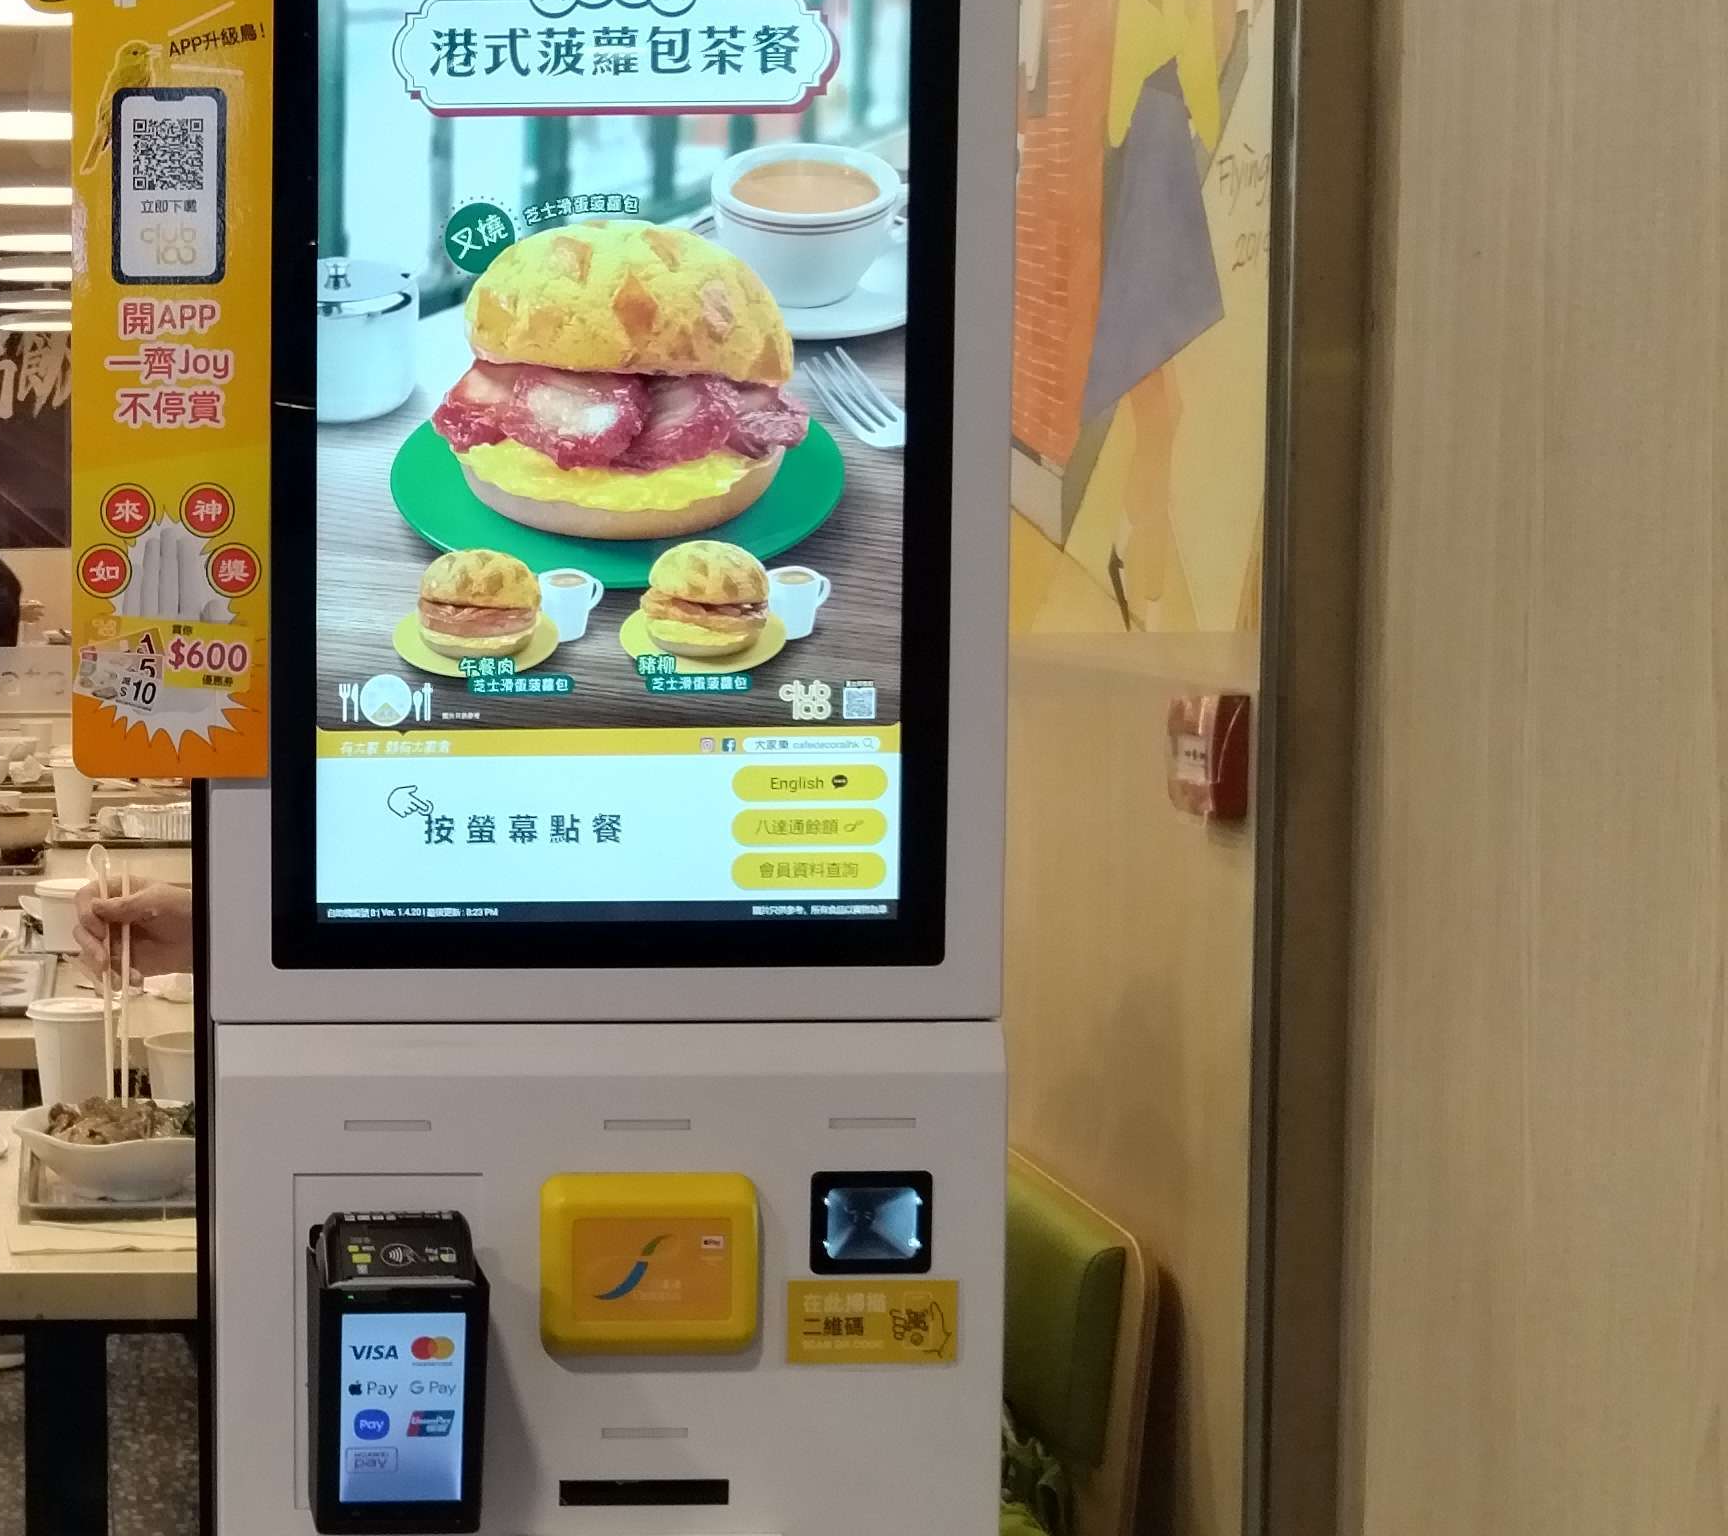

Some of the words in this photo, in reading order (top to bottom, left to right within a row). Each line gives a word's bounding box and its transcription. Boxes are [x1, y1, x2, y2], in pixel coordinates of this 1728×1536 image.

[428, 24, 802, 78] 港式菠蘿包茶餐
[451, 213, 509, 260] 叉燒
[122, 302, 218, 336] 開APP
[108, 346, 231, 380] 一齊Joy
[118, 390, 222, 425] 不停賞
[168, 637, 248, 673] $600
[459, 658, 514, 676] 午餐肉
[638, 657, 676, 675] 豬柳
[770, 777, 824, 793] English
[423, 814, 623, 845] 按螢幕點餐
[759, 862, 859, 879] 會員資料查詢
[802, 1316, 865, 1337] 二維碼
[349, 1344, 399, 1361] VISA
[367, 1381, 399, 1398] Pay
[429, 1381, 457, 1397] Pay
[359, 1418, 386, 1433] Pay
